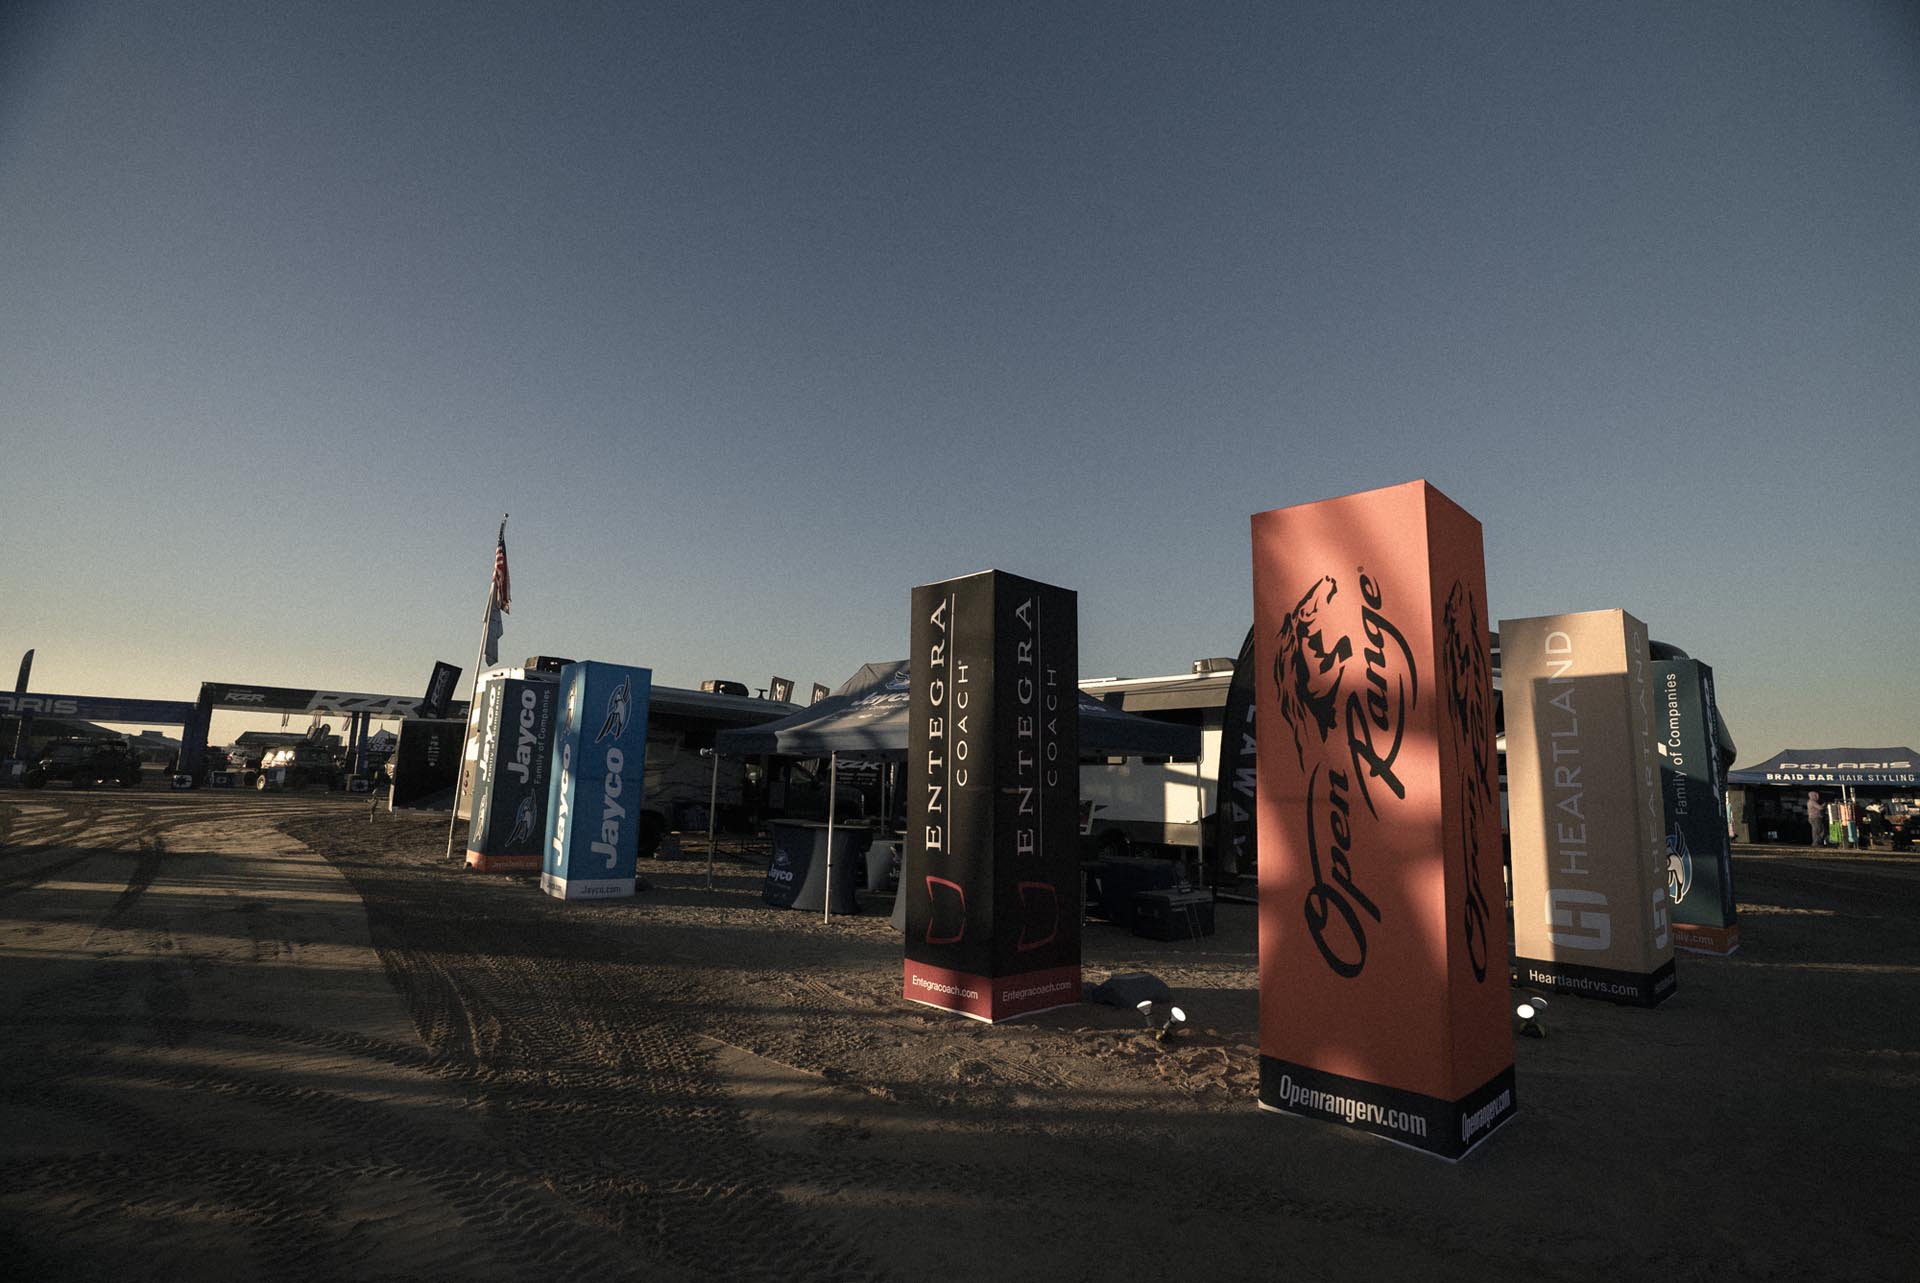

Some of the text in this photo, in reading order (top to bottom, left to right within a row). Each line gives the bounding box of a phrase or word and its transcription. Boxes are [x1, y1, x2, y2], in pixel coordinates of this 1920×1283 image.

[507, 689, 537, 784] Jayco
[926, 598, 947, 851] ENTEGRA
[957, 664, 969, 787] COACH
[1016, 597, 1034, 856] ENTEGRA
[1047, 668, 1058, 787] COACH
[1665, 673, 1681, 747] Companies
[533, 754, 544, 784] Family
[1304, 574, 1418, 978] Open Range
[1545, 630, 1589, 875] HEARTLAND
[1633, 631, 1660, 874] HEARTLAND
[1673, 751, 1684, 766] of
[1675, 771, 1688, 815] Family
[1766, 773, 1804, 781] BRAID
[1839, 774, 1864, 782] HAIR
[1868, 774, 1915, 782] STYLING
[1779, 761, 1912, 770] POLARIS
[552, 743, 571, 867] Jayco
[591, 747, 626, 869] Jayco
[912, 975, 979, 1000] Entegracoach.com
[1002, 981, 1072, 1001] Entegracoach.com
[1529, 969, 1639, 998] Heartlandrvs.com
[1280, 1075, 1428, 1137] Openrangerv.com
